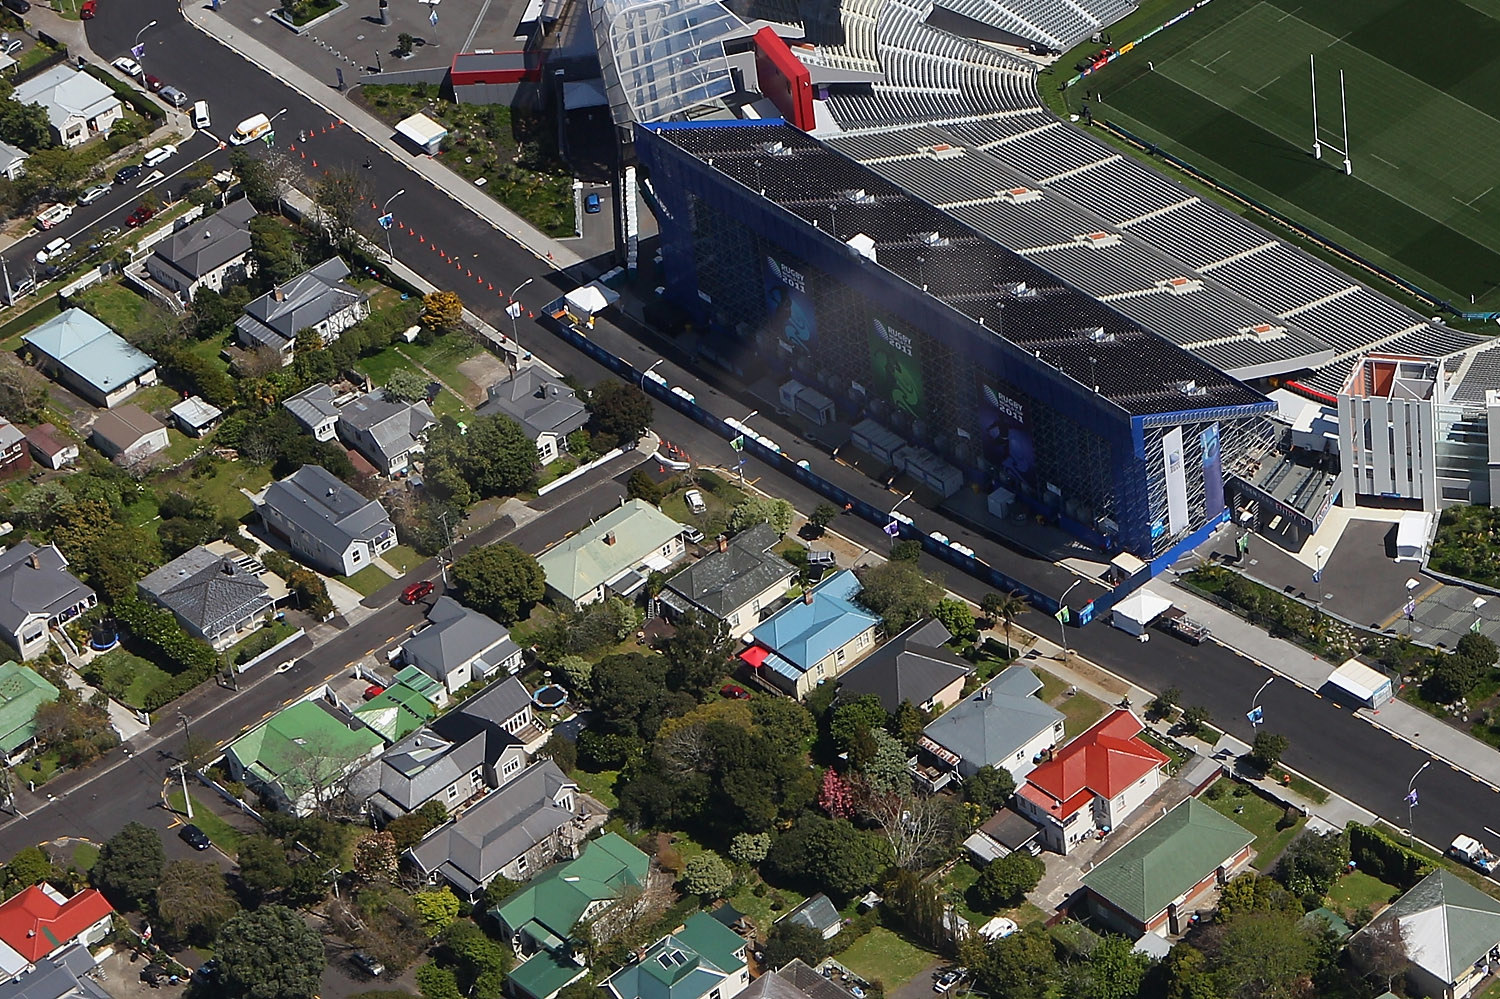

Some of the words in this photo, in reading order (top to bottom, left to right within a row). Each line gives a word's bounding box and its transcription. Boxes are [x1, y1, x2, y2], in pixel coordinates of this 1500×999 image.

[781, 263, 805, 281] RUGBY
[782, 276, 806, 293] 2011
[888, 326, 912, 345] RUGBY
[889, 339, 912, 357] 2011
[998, 392, 1023, 411] RUGBY
[999, 405, 1024, 424] 2011
